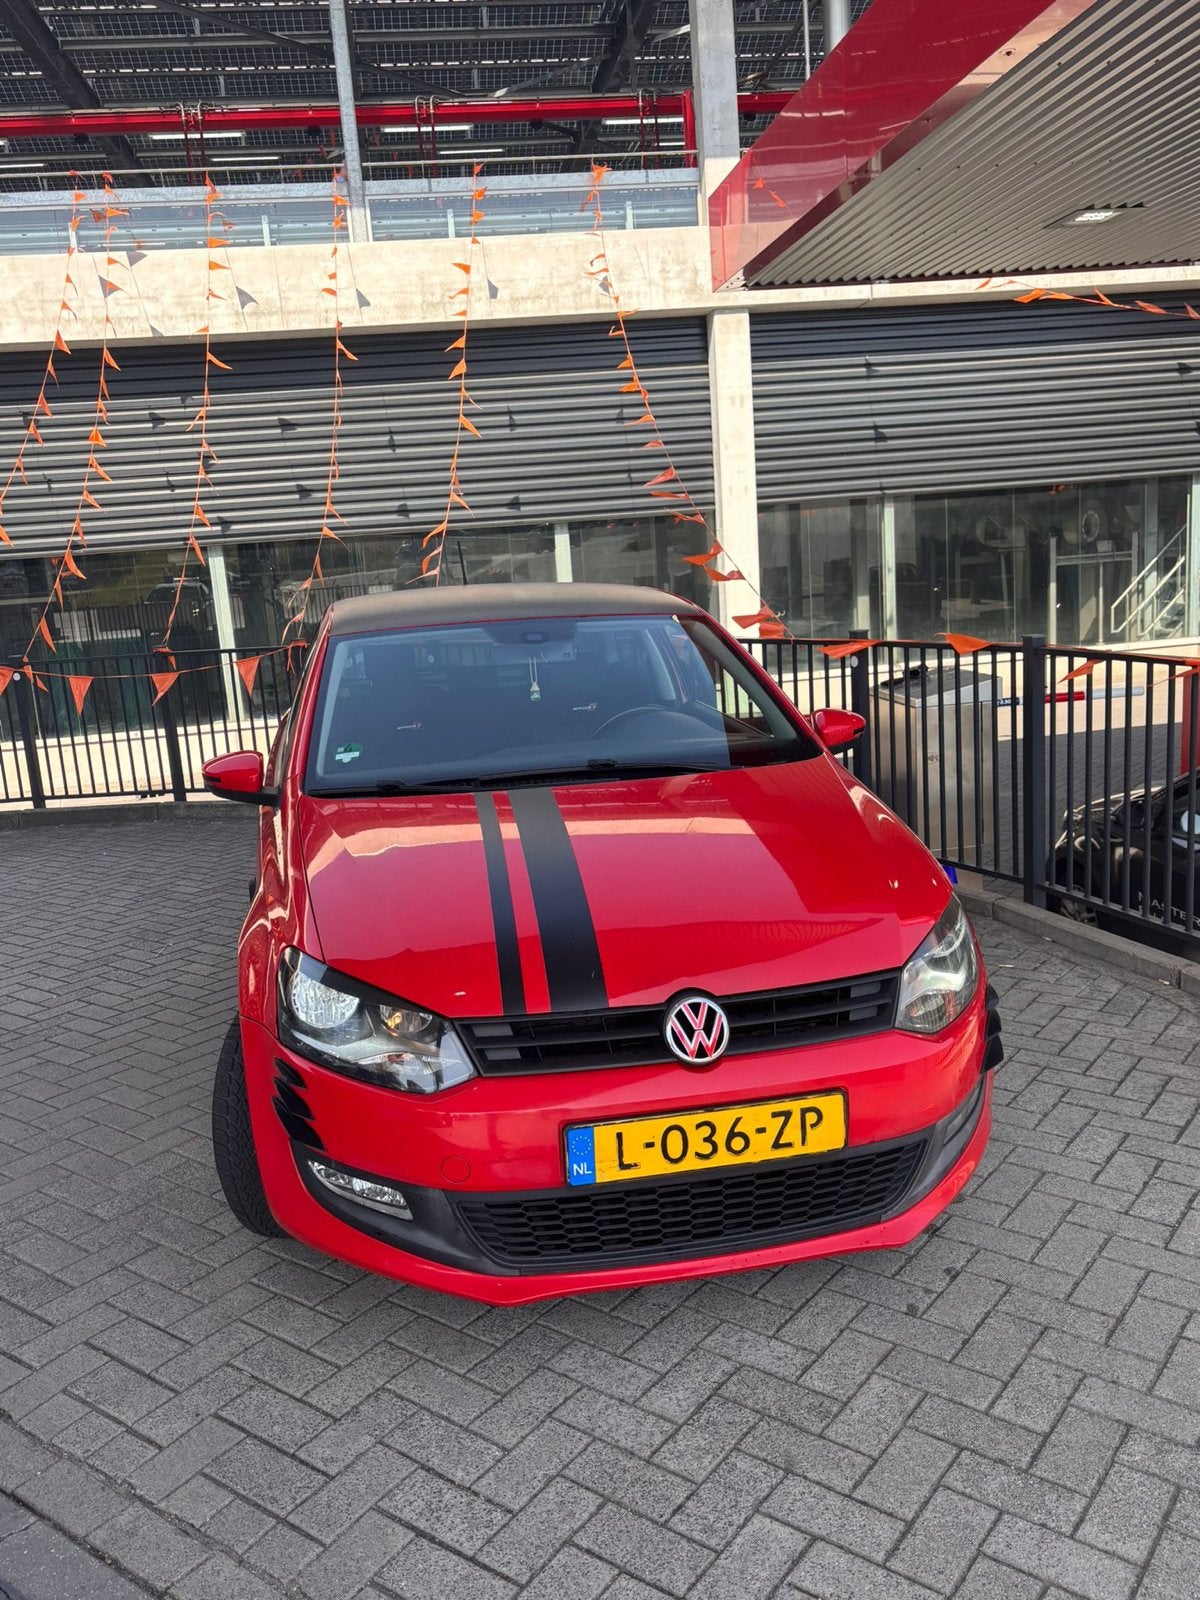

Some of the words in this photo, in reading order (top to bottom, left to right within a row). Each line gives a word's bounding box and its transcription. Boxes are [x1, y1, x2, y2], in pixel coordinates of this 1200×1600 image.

[668, 1000, 725, 1061] VW
[615, 1105, 824, 1171] L-036-ZP
[573, 1162, 593, 1176] NL
